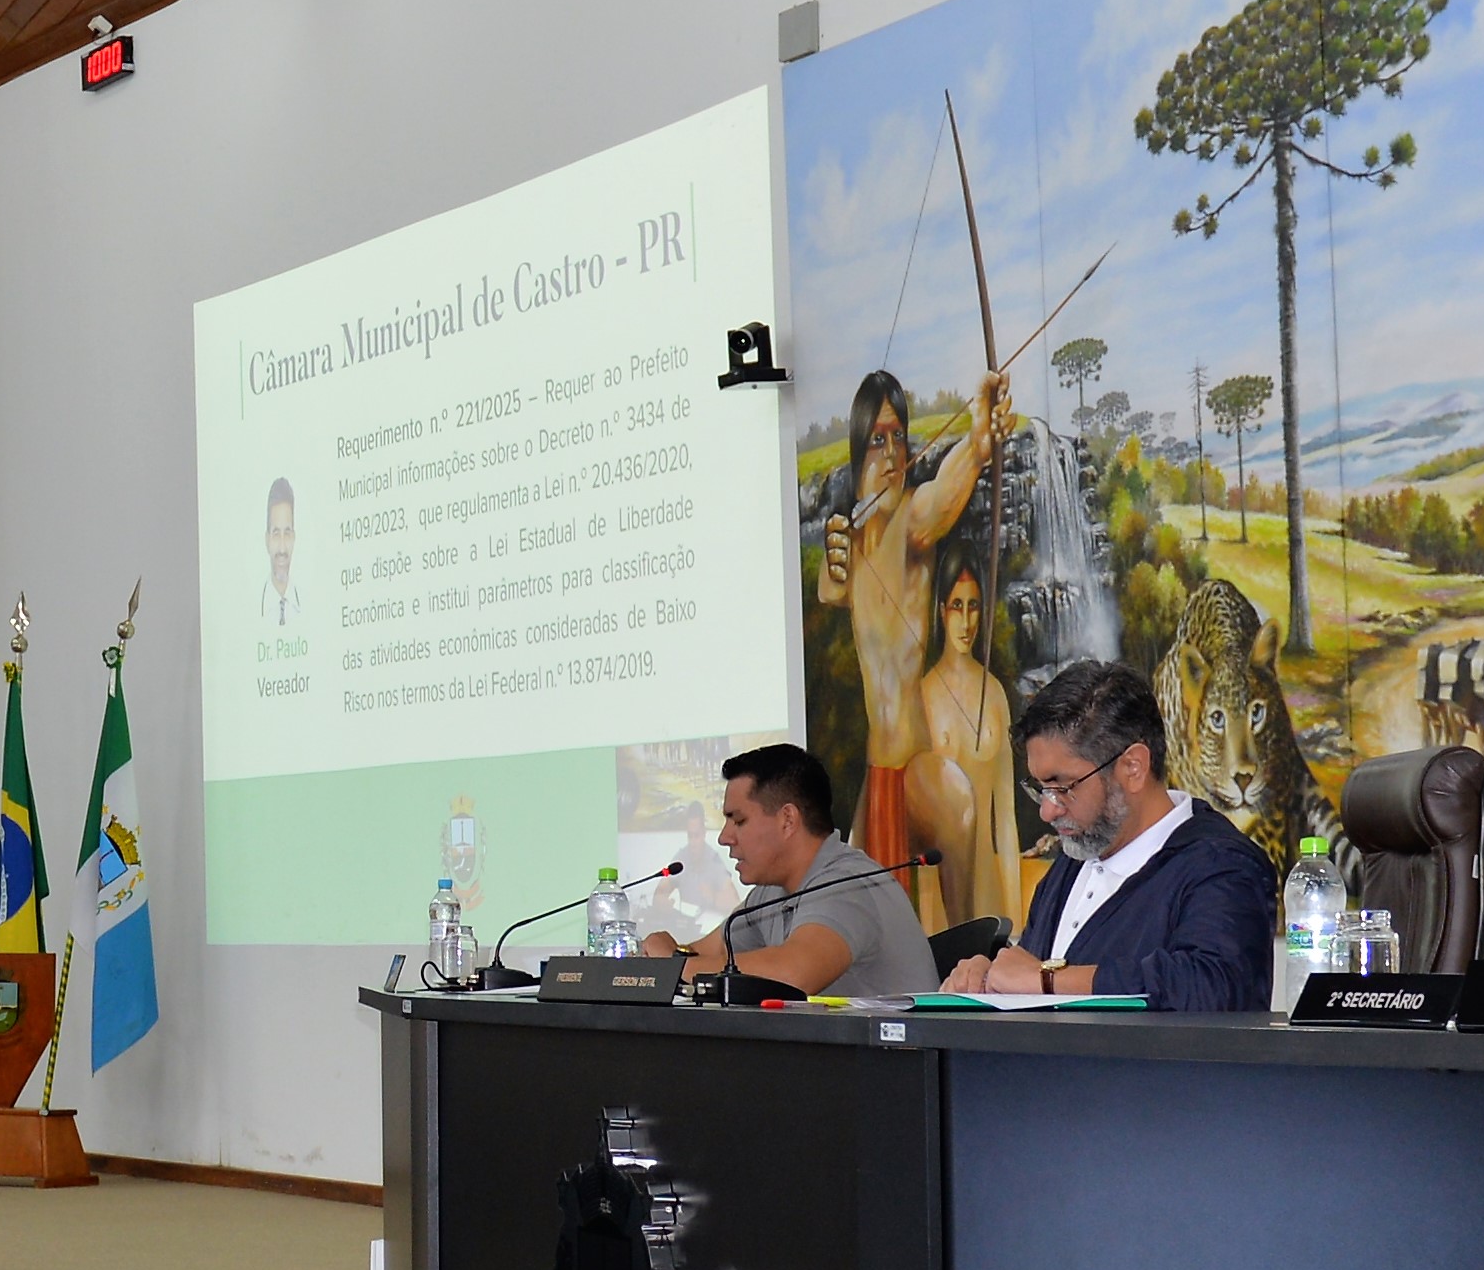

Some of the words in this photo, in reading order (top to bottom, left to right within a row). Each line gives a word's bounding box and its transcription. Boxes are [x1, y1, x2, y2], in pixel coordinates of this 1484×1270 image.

[249, 343, 334, 396] Câmara
[341, 284, 463, 369] Municipal
[472, 275, 504, 327] de
[514, 253, 605, 314] Castro
[638, 210, 685, 275] PR
[337, 418, 423, 460] Requerimento
[456, 388, 521, 428] 221/2025
[545, 372, 595, 404] Requer
[604, 366, 622, 388] ao
[630, 345, 689, 381] Prefeito
[339, 467, 392, 502] Municipal
[397, 450, 476, 486] informações
[481, 441, 519, 468] sobre
[525, 439, 533, 457] o
[539, 421, 594, 454] Decreto
[627, 398, 665, 432] 3434
[672, 394, 691, 421] de
[340, 507, 409, 543] 14/09/2023,
[419, 504, 443, 530] que
[447, 485, 529, 523] regulamenta
[533, 483, 541, 502] a
[545, 472, 564, 500] Lei
[592, 443, 693, 489] 20.436/2020,
[341, 565, 362, 591] que
[372, 551, 412, 582] dispõe
[422, 545, 459, 570] sobre
[470, 543, 477, 562] a
[489, 533, 508, 558] Lei
[519, 517, 576, 552] Estadual
[588, 513, 606, 538] de
[619, 494, 694, 532] Liberdade
[342, 598, 405, 628] Econômica
[412, 598, 420, 615] e
[429, 584, 470, 613] institui
[478, 575, 553, 611] parâmetros
[562, 567, 593, 597] para
[602, 544, 695, 583] classificação
[258, 641, 273, 663] Dr.
[277, 635, 308, 659] Paulo
[342, 649, 362, 671] das
[370, 638, 430, 667] atividades
[439, 627, 517, 656] econômicas
[526, 609, 618, 644] consideradas
[627, 604, 646, 630] de
[656, 598, 696, 625] Baixo
[257, 671, 310, 698] Vereador
[344, 690, 374, 713] Risco
[378, 687, 399, 709] nos
[402, 681, 445, 707] termos
[449, 677, 465, 700] da
[469, 674, 488, 698] Lei
[491, 666, 541, 696] Federal
[568, 650, 657, 686] 13.874/2019.
[1326, 991, 1343, 1007] 2º
[1341, 989, 1425, 1010] SECRETÁRIO
